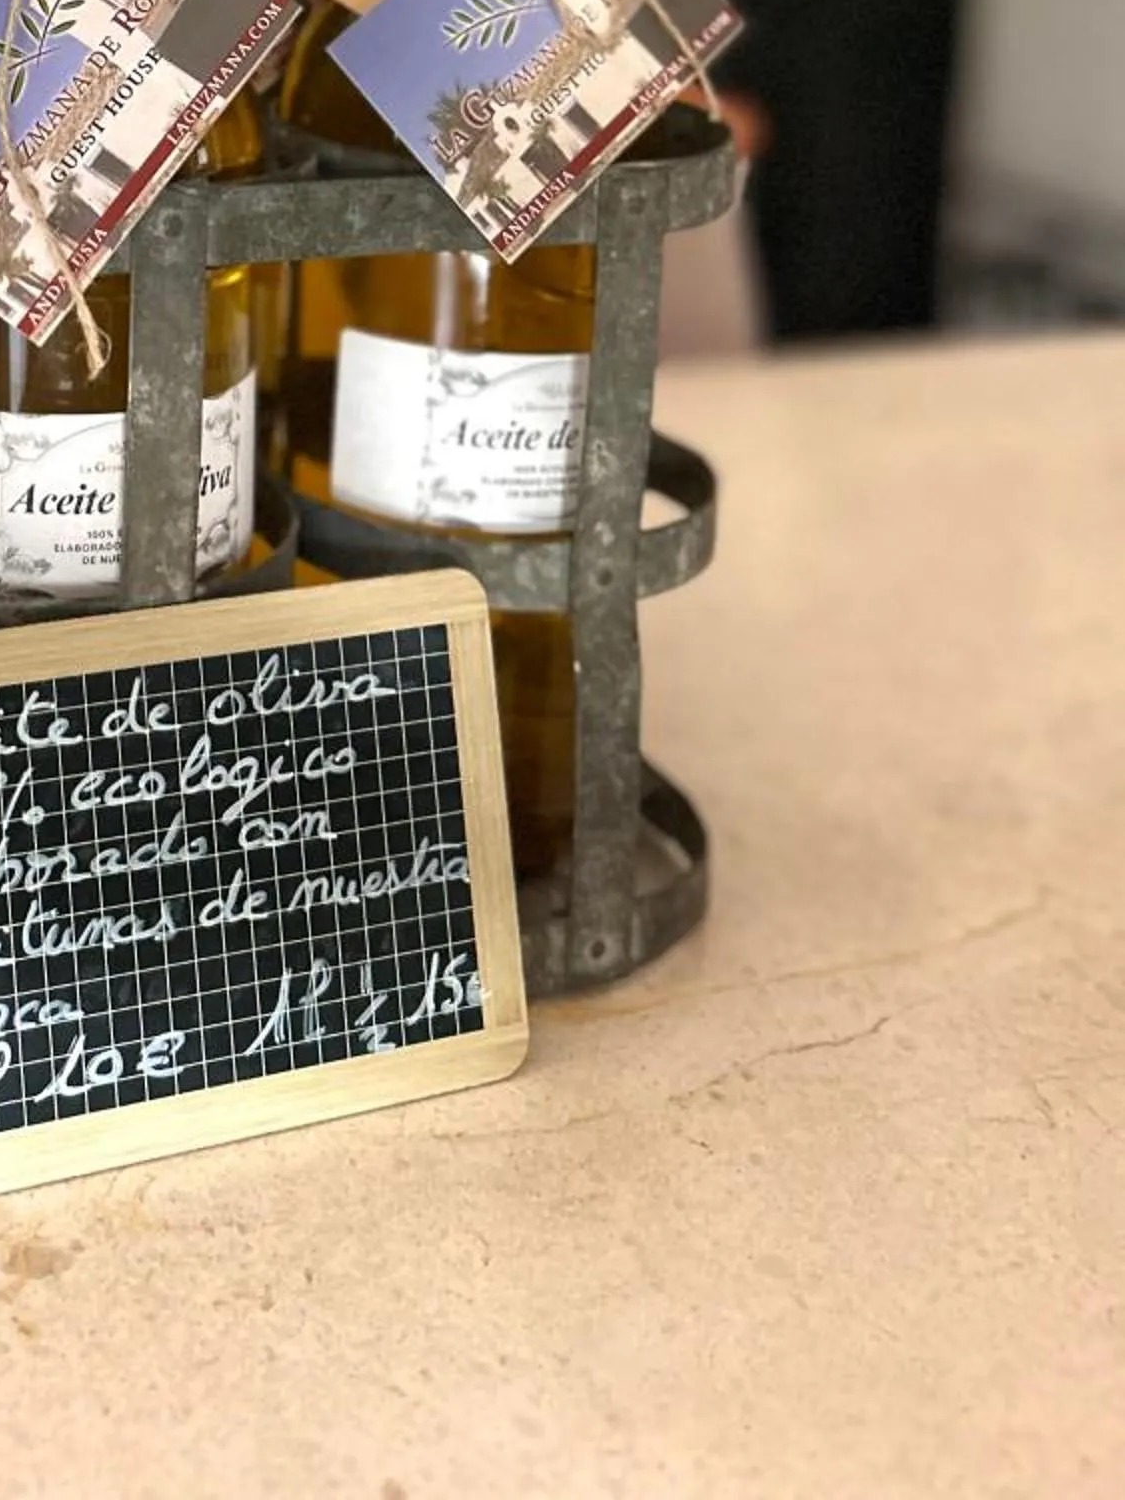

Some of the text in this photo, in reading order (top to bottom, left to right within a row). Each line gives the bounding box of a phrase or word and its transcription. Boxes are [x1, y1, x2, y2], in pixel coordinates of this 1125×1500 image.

[88, 34, 123, 72] DE
[166, 1, 284, 145] LAGUZMANA.COM
[50, 47, 164, 184] GUEST HOUSE
[530, 74, 580, 126] GUEST
[431, 131, 470, 166] LA
[502, 169, 575, 245] ANDALUSIA
[25, 227, 109, 328] ANDAUSIA
[439, 418, 580, 451] Aceite de
[8, 483, 117, 516] Aceite
[101, 675, 181, 738] de
[207, 651, 397, 725] oliva
[198, 867, 268, 927] de
